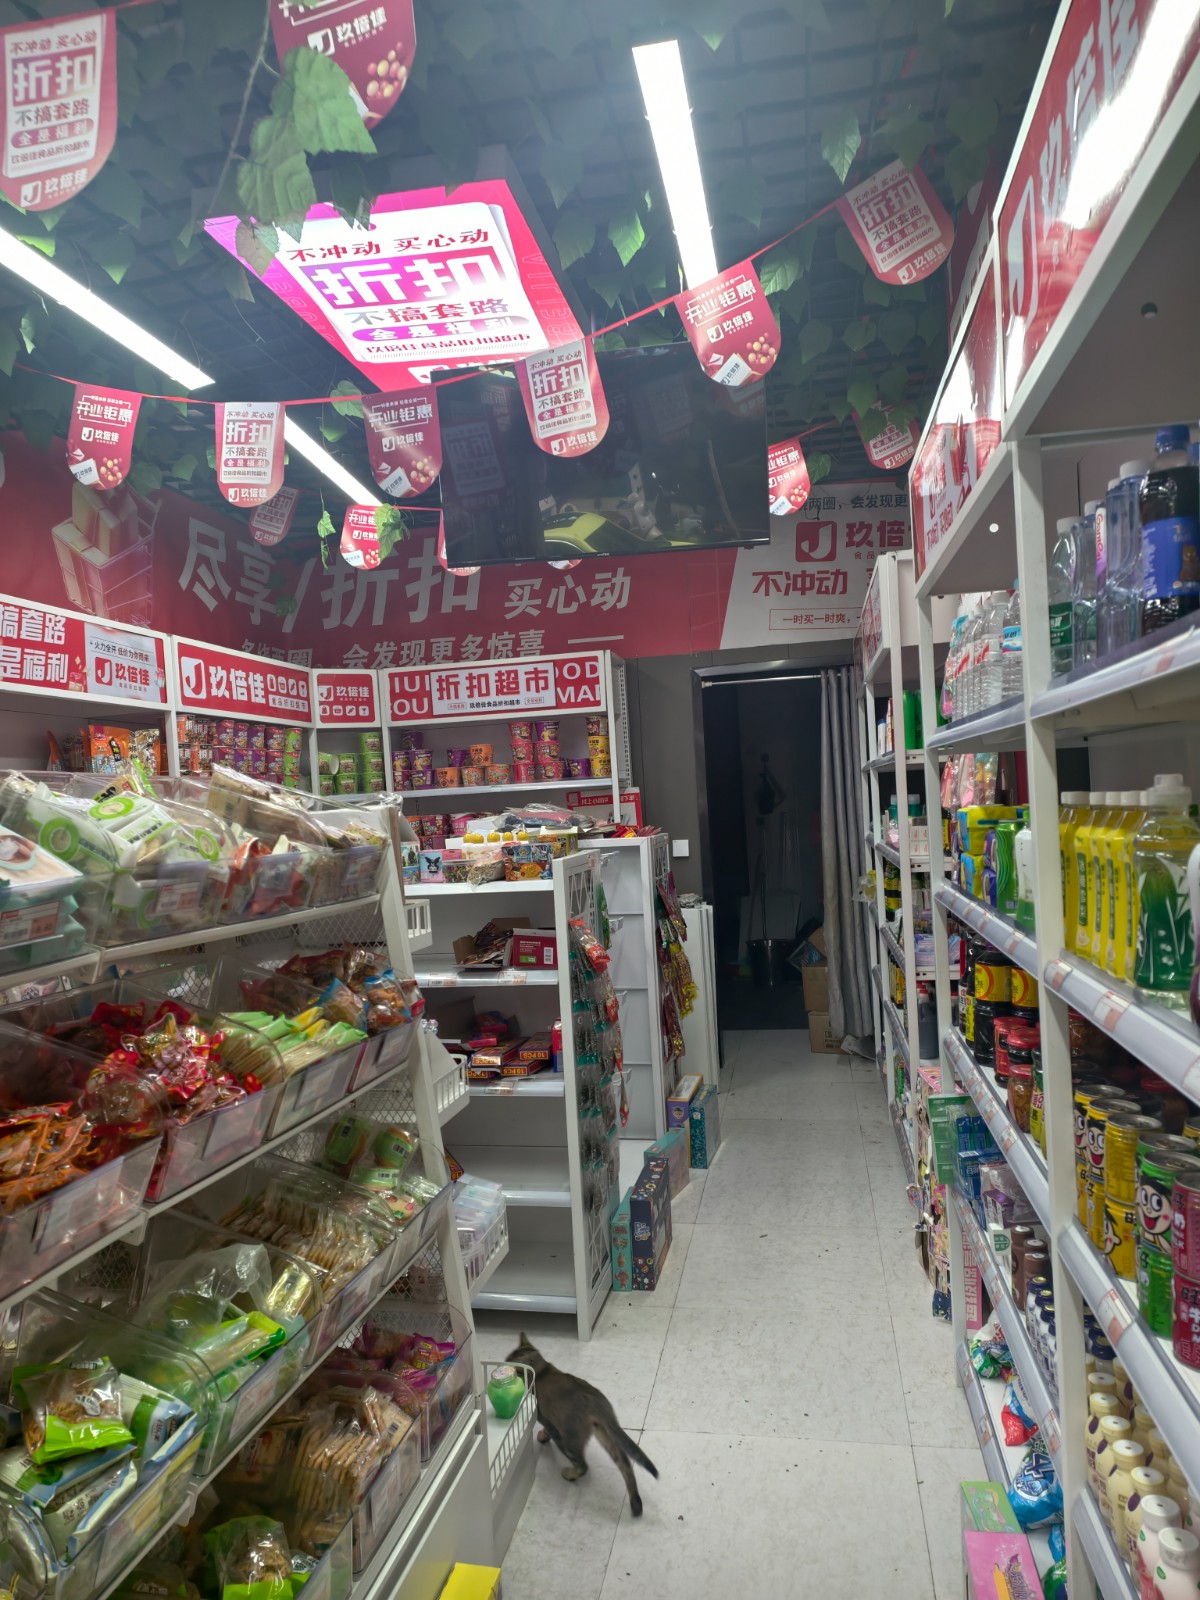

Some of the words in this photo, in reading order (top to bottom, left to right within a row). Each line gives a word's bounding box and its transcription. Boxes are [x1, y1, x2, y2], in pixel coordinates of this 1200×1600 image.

[335, 6, 387, 43] 玖倍佳
[13, 54, 95, 102] 折扣
[44, 167, 89, 194] 玖倍佳
[861, 180, 912, 228] 折扣
[872, 206, 921, 240] 不搞套路
[291, 241, 381, 262] 不冲动
[394, 229, 489, 251] 买心动
[913, 242, 946, 268] 玖倍佳
[311, 254, 508, 305] 折扣
[344, 298, 510, 326] 不搞套路
[685, 279, 756, 323] 开业钜惠
[723, 311, 753, 332] 玖倍佳
[534, 364, 585, 396] 折扣
[538, 388, 585, 409] 不搞套路
[77, 401, 134, 423] 开业钜惠
[369, 404, 432, 428] 开业钜惠
[95, 430, 119, 442] 玖倍佳
[227, 422, 271, 443] 折扣
[396, 432, 424, 445] 玖倍佳
[566, 431, 597, 446] 玖倍佳
[226, 447, 267, 457] 不搞套路
[768, 450, 800, 470] 业钜惠
[241, 488, 267, 498] 玖倍佳
[846, 520, 911, 547] 玖倍
[503, 567, 632, 620] 买心动
[752, 569, 848, 596] 不冲动
[783, 613, 861, 625] 一时买一时爽，
[94, 641, 117, 654] 火力全开
[343, 630, 545, 668] 会发现更多惊喜
[115, 663, 150, 686] 玖倍佳
[435, 667, 550, 700] 折扣超市
[556, 662, 601, 681] OD
[208, 666, 266, 704] 玖倍佳
[336, 685, 370, 699] 玖倍佳
